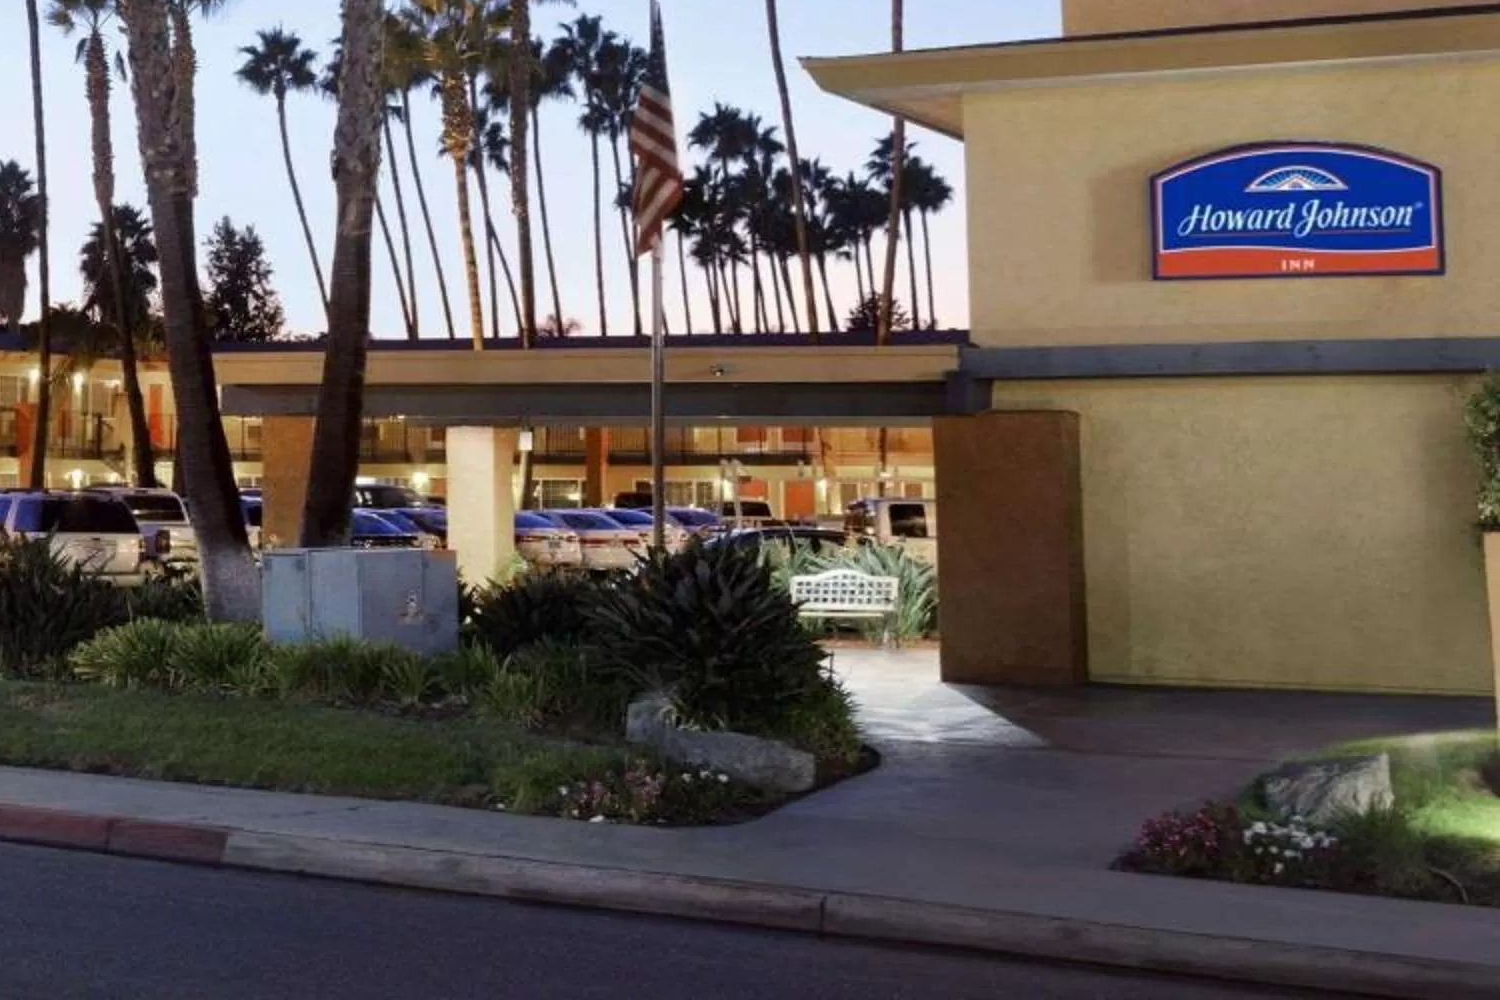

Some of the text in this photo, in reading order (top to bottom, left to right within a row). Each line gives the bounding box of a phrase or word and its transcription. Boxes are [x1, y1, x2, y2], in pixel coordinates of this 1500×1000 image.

[1177, 199, 1412, 239] Howard Johnson
[1280, 259, 1316, 271] INN
